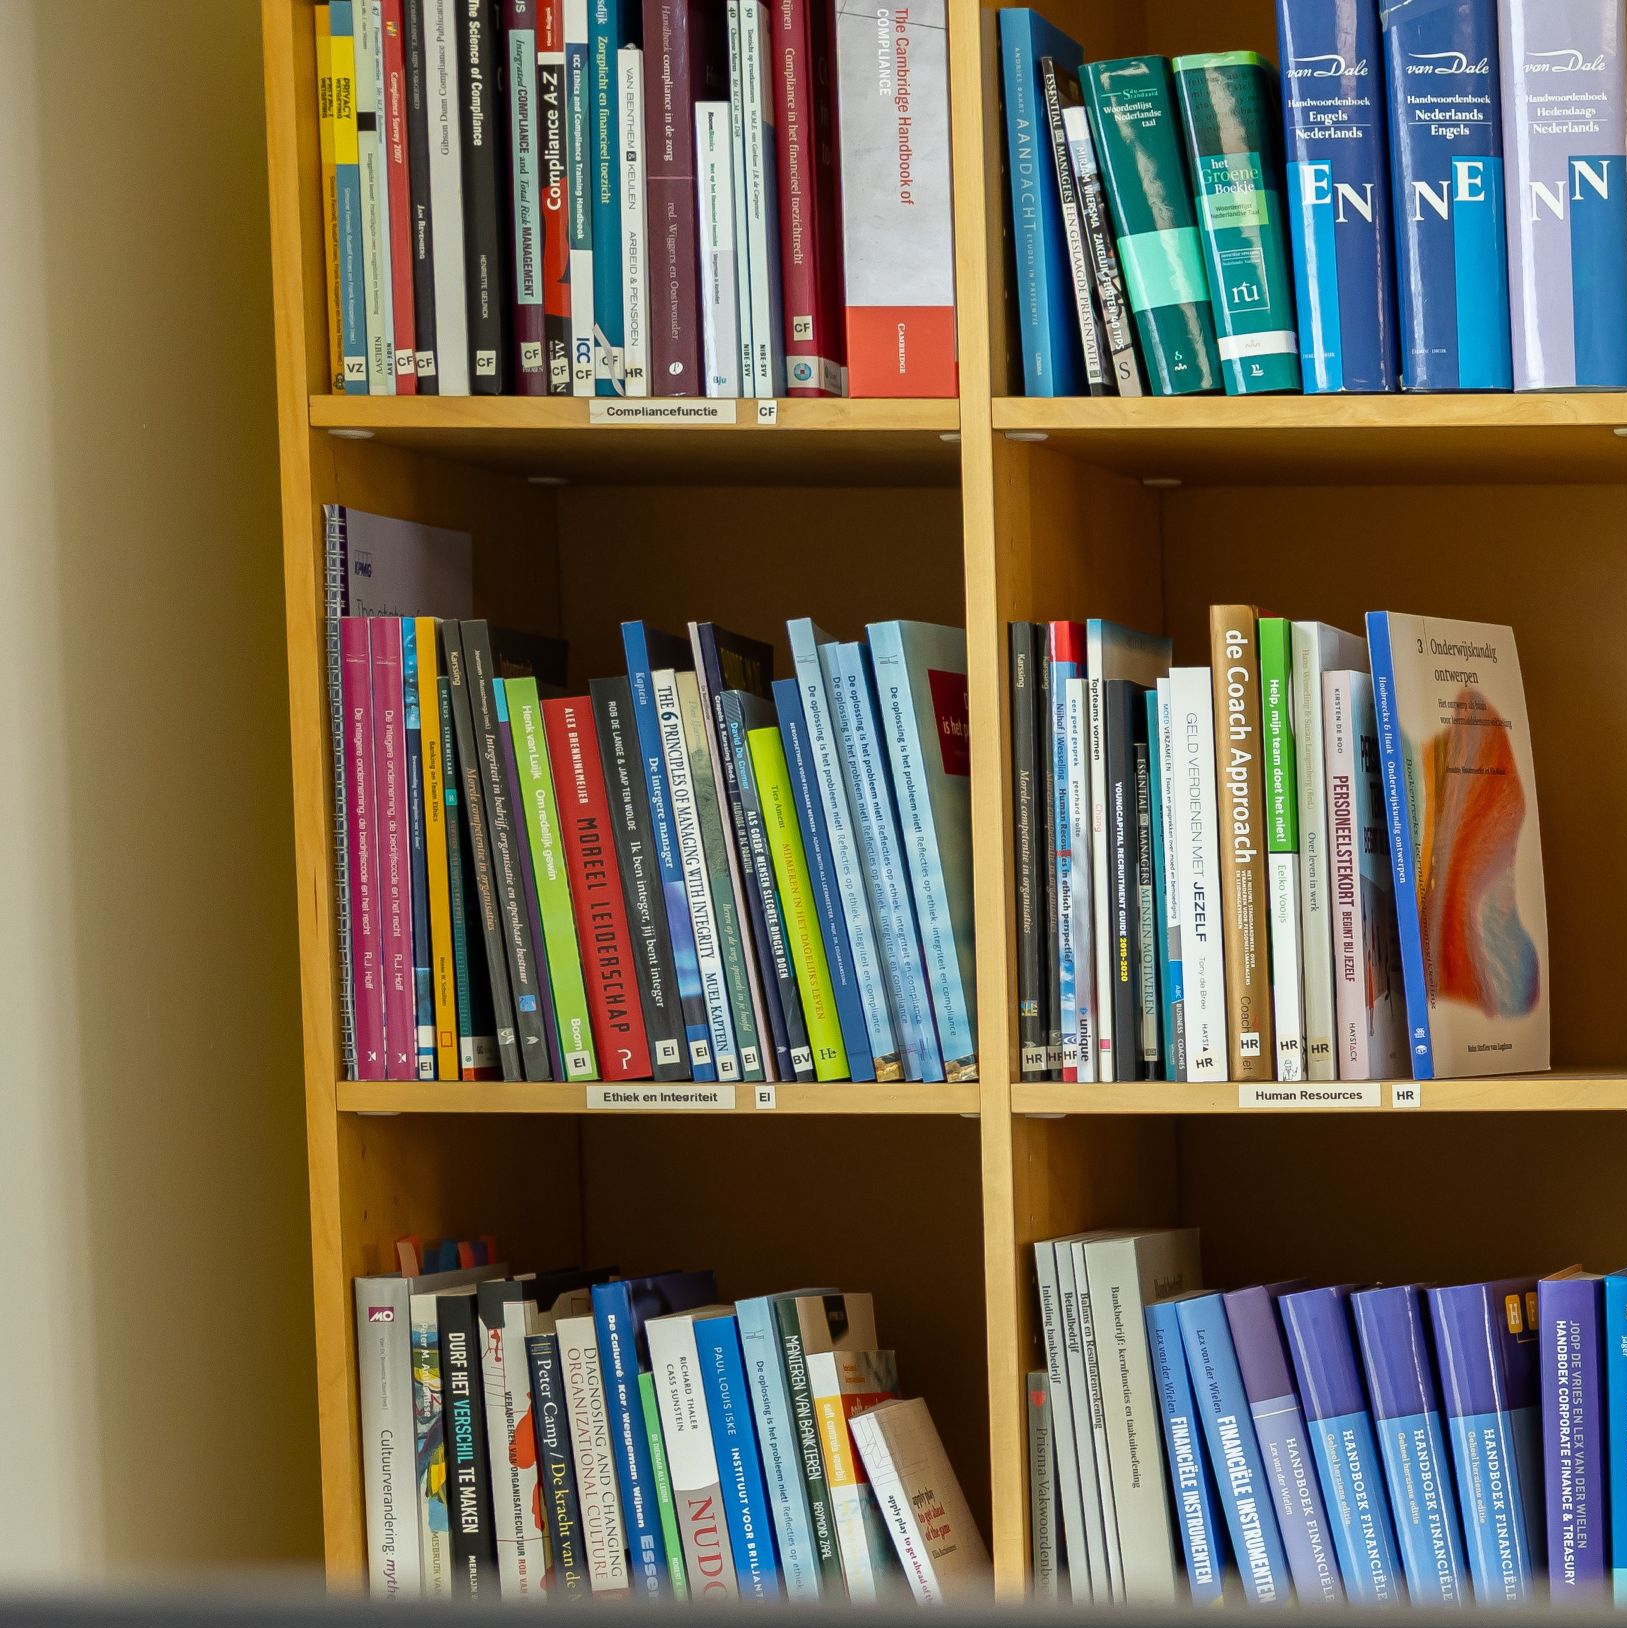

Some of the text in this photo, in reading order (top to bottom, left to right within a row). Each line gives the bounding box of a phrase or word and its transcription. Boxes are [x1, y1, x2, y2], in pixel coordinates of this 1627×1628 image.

[877, 8, 891, 96] COMPLIANCE
[894, 8, 914, 205] The Cambridge Handbook of
[1288, 98, 1370, 108] Handwoordenboek
[1309, 111, 1348, 123] Engels
[543, 72, 564, 210] Compliance A-Z
[1295, 127, 1363, 139] Nederlands
[1201, 169, 1258, 185] Groene
[1211, 159, 1228, 169] het
[1215, 182, 1255, 194] Boekje
[897, 323, 906, 374] CAMBRIDGE
[477, 357, 494, 367] CF
[606, 406, 717, 420] Compliancefunctie
[760, 407, 775, 417] CF
[1429, 639, 1497, 665] Onderwijskundig
[1434, 666, 1479, 685] ontwerpen
[1224, 629, 1255, 863] de Coach Approach
[1186, 712, 1207, 943] GELD VERDIENEN MET JEZELF
[1333, 775, 1355, 906] PERSONEELSTEKORT
[656, 685, 728, 1051] THE 6 PRINCIPLES OF MANAGING WITH INTEGRITY MUEL KAPTEIN
[577, 817, 630, 1033] MOREEL LEIDERSCHAP
[1311, 1043, 1329, 1054] HR
[604, 1092, 717, 1104] Ethiek en Integriteit
[759, 1092, 770, 1102] EI
[1255, 1089, 1362, 1100] Human Resources
[1396, 1088, 1414, 1101] HR
[1556, 1320, 1568, 1385] HANDBOEK
[449, 1332, 479, 1534] DURF HET VERSCHIL TE MAKEN
[1558, 1389, 1570, 1454] CORPORATE
[1217, 1415, 1253, 1497] FINANCIËLE
[1560, 1459, 1571, 1508] FINANCE
[1562, 1525, 1575, 1586] TREASURY
